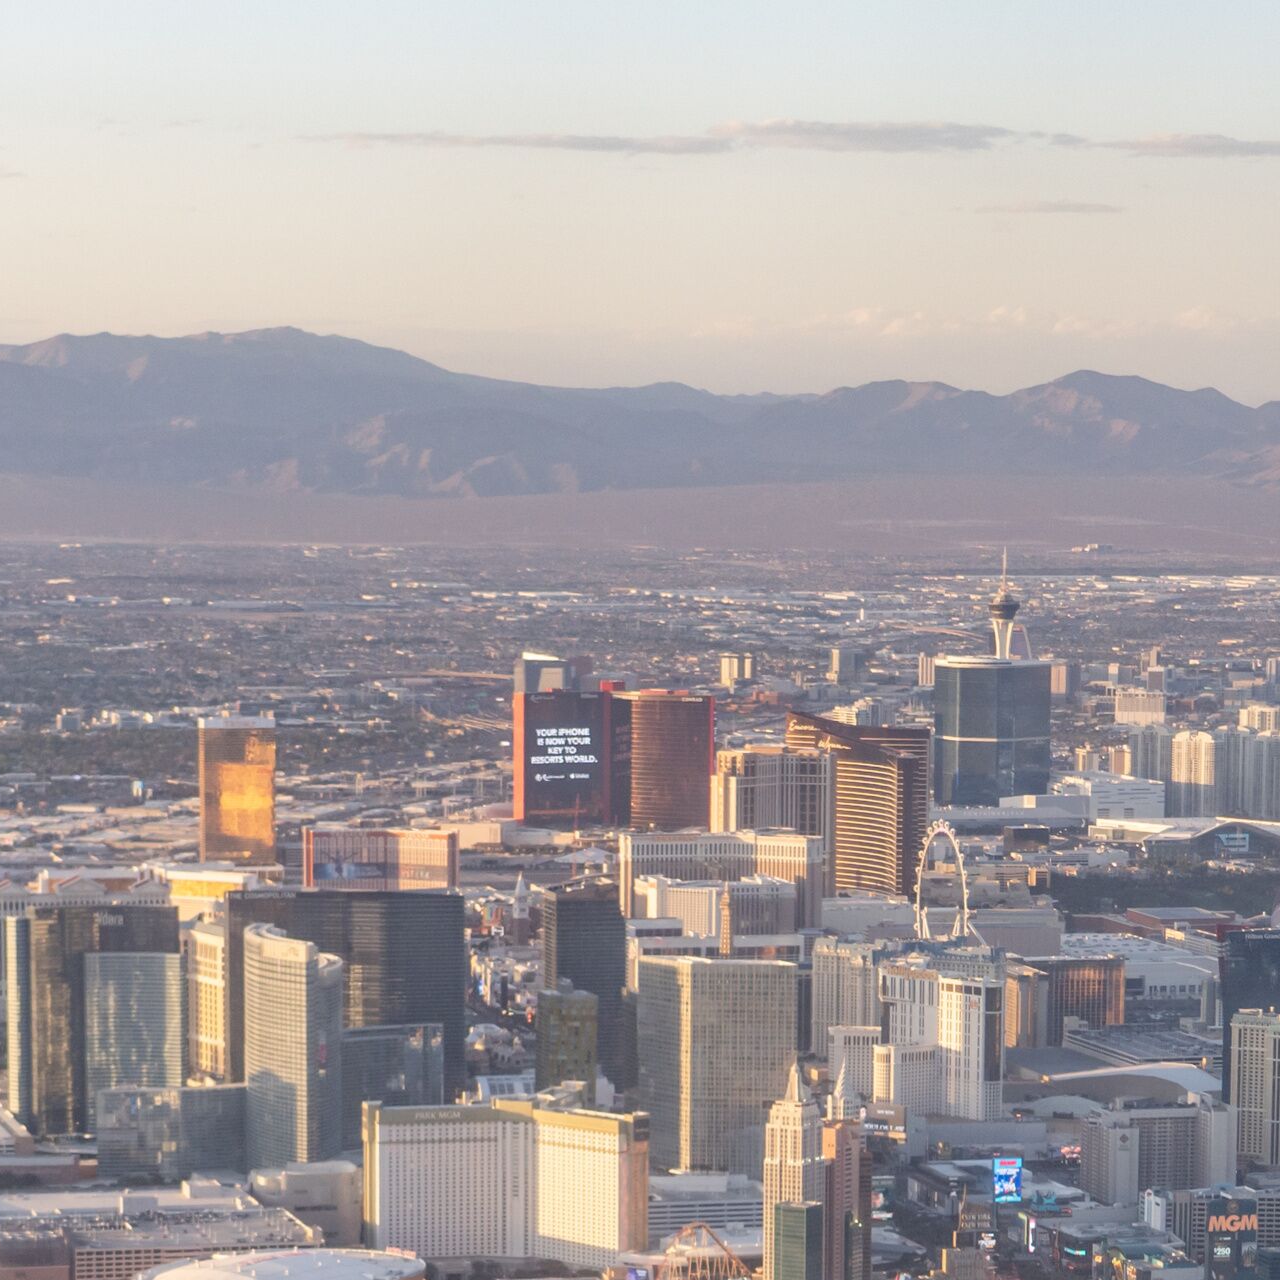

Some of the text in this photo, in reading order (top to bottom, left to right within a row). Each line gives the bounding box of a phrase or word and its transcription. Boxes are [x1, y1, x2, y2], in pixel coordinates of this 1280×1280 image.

[567, 737, 591, 745] YOUR
[564, 746, 577, 754] TO
[1208, 1214, 1258, 1232] MGM
